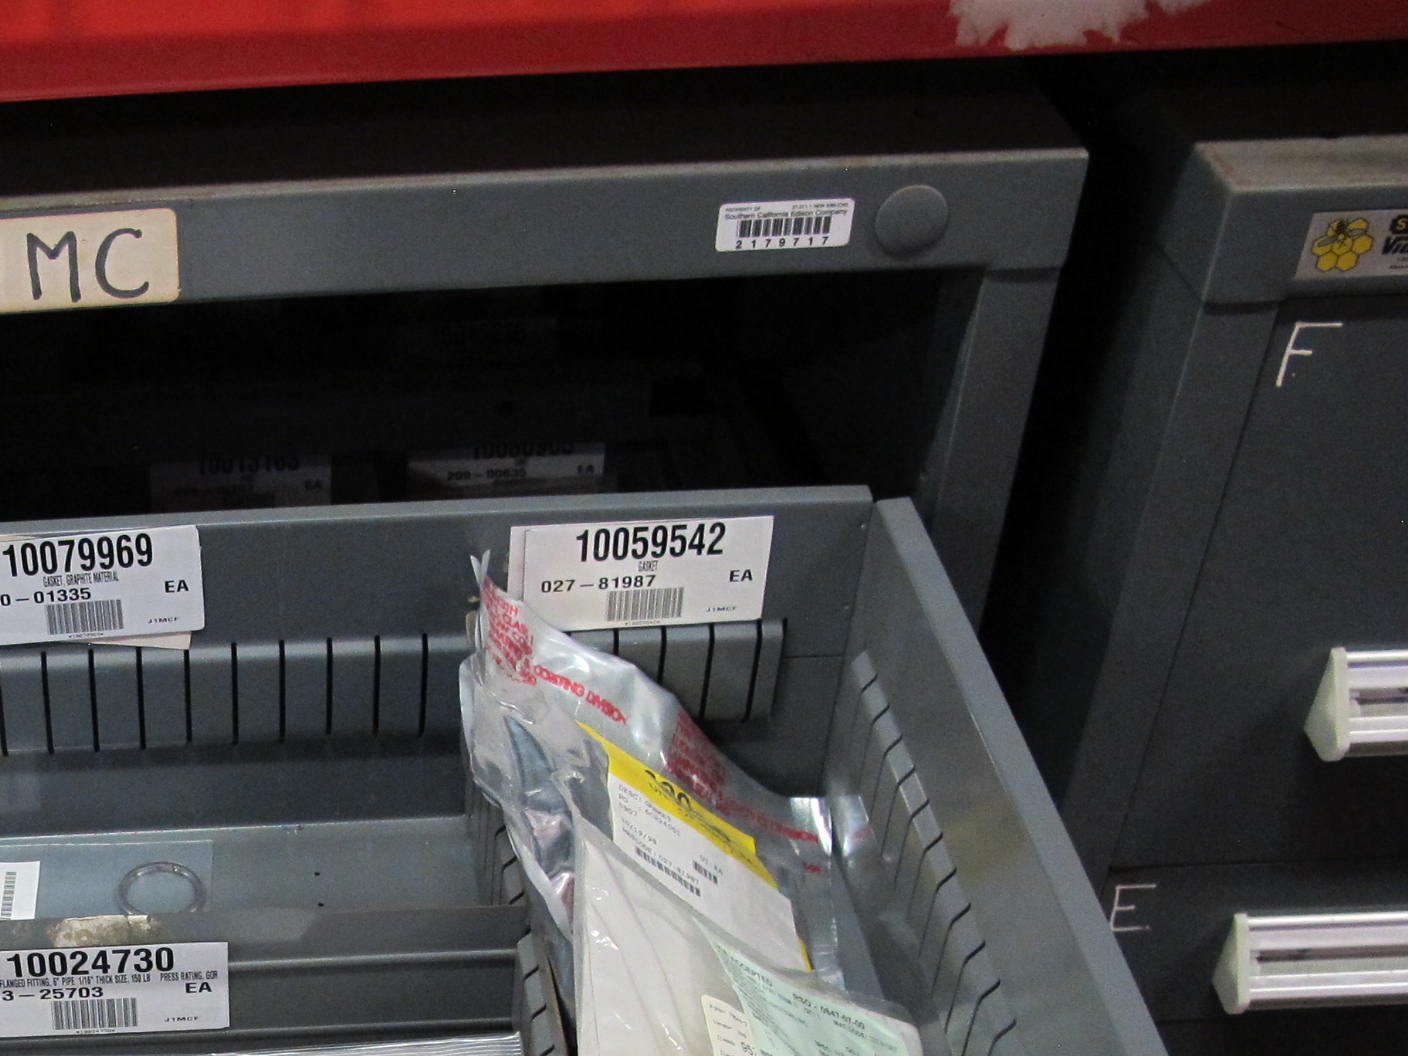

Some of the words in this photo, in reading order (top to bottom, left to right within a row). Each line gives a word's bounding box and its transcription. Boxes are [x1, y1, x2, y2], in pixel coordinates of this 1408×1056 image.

[1275, 320, 1344, 387] F
[3, 533, 153, 577] 10079969
[576, 522, 726, 562] 10059542
[164, 579, 189, 593] EA
[729, 569, 753, 582] EA
[1110, 884, 1157, 932] E
[7, 947, 174, 978] 10024730
[185, 982, 212, 994] EA
